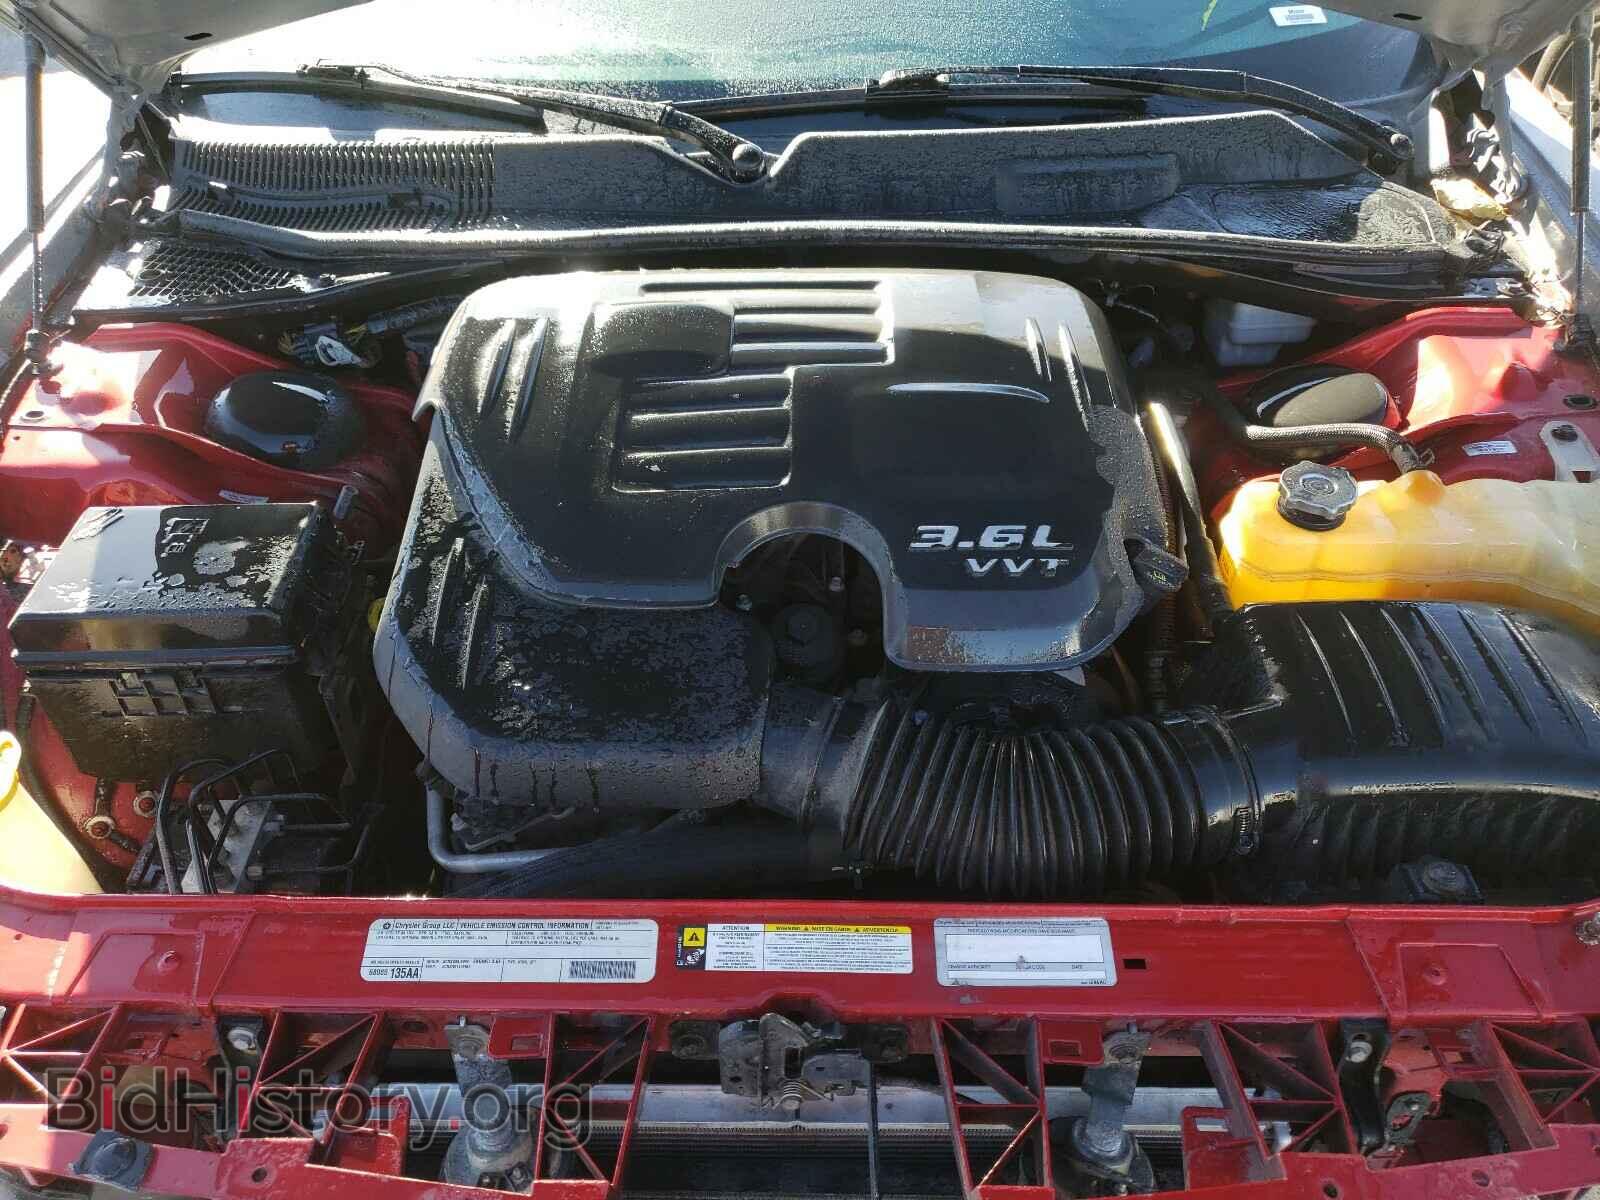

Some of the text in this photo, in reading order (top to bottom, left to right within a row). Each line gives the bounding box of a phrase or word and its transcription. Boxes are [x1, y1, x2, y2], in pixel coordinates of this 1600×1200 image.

[908, 525, 1074, 550] 3.6L
[964, 558, 1069, 577] VVT
[395, 922, 420, 930] Chrysler
[422, 922, 441, 930] Group
[390, 967, 419, 979] 135AA
